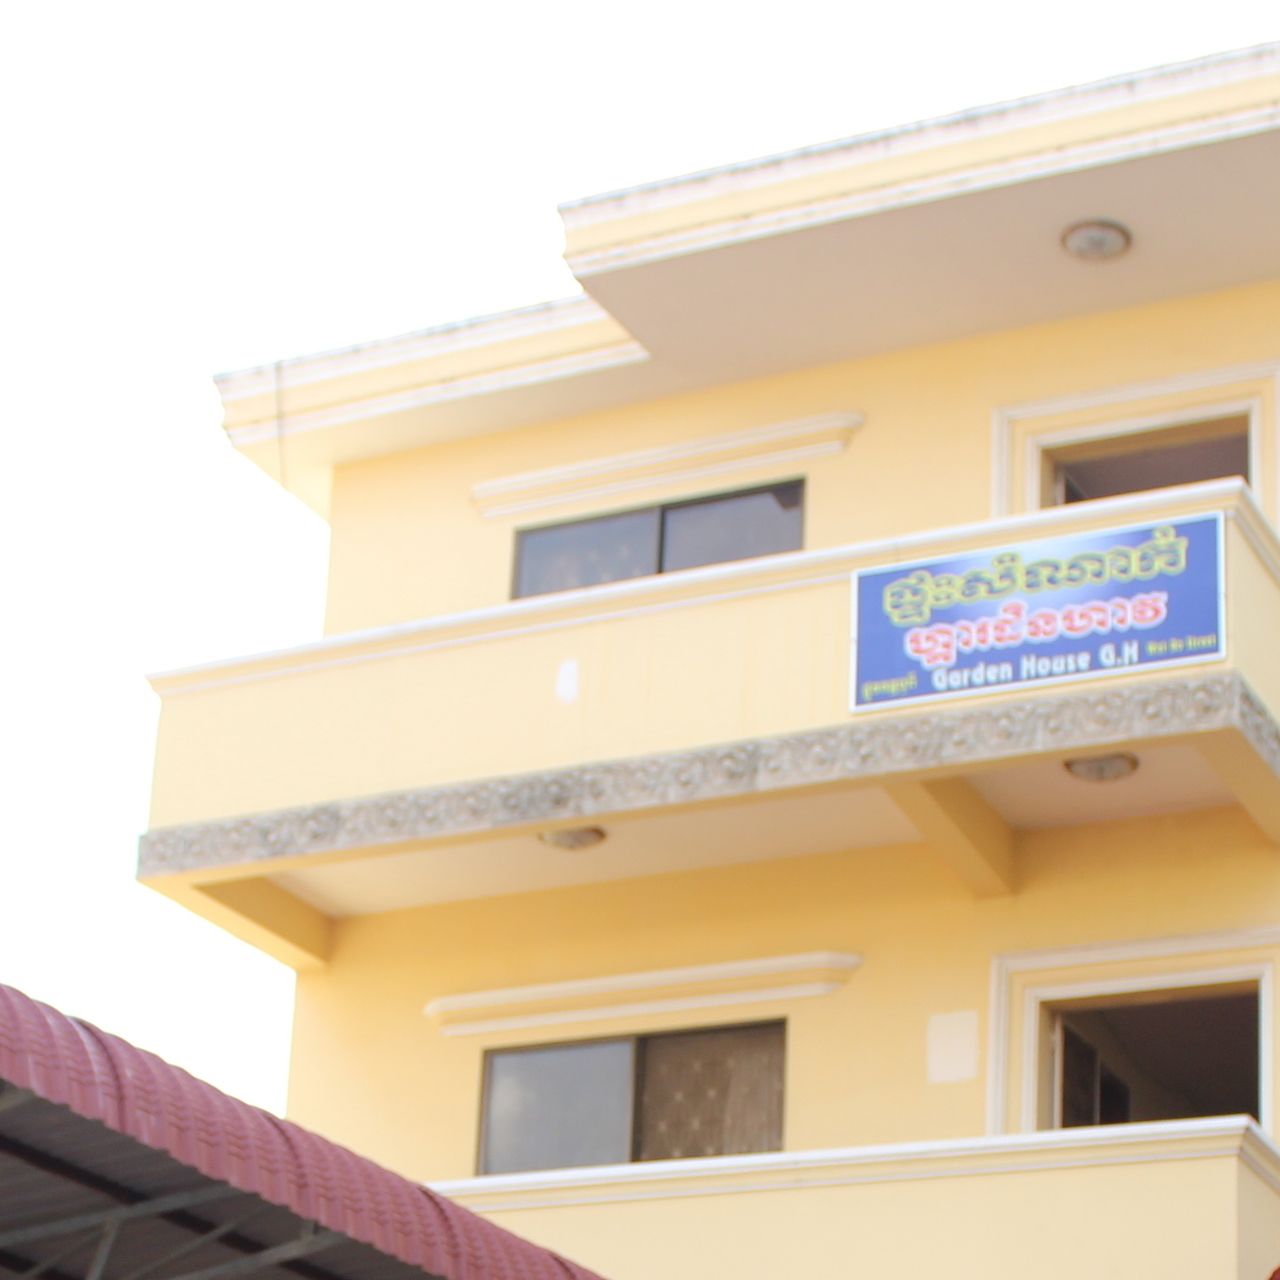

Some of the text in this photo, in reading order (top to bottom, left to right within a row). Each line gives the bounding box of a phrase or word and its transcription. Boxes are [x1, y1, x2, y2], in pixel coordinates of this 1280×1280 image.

[932, 663, 1013, 692] Garden
[1021, 652, 1090, 680] House
[1099, 640, 1139, 667] G.H
